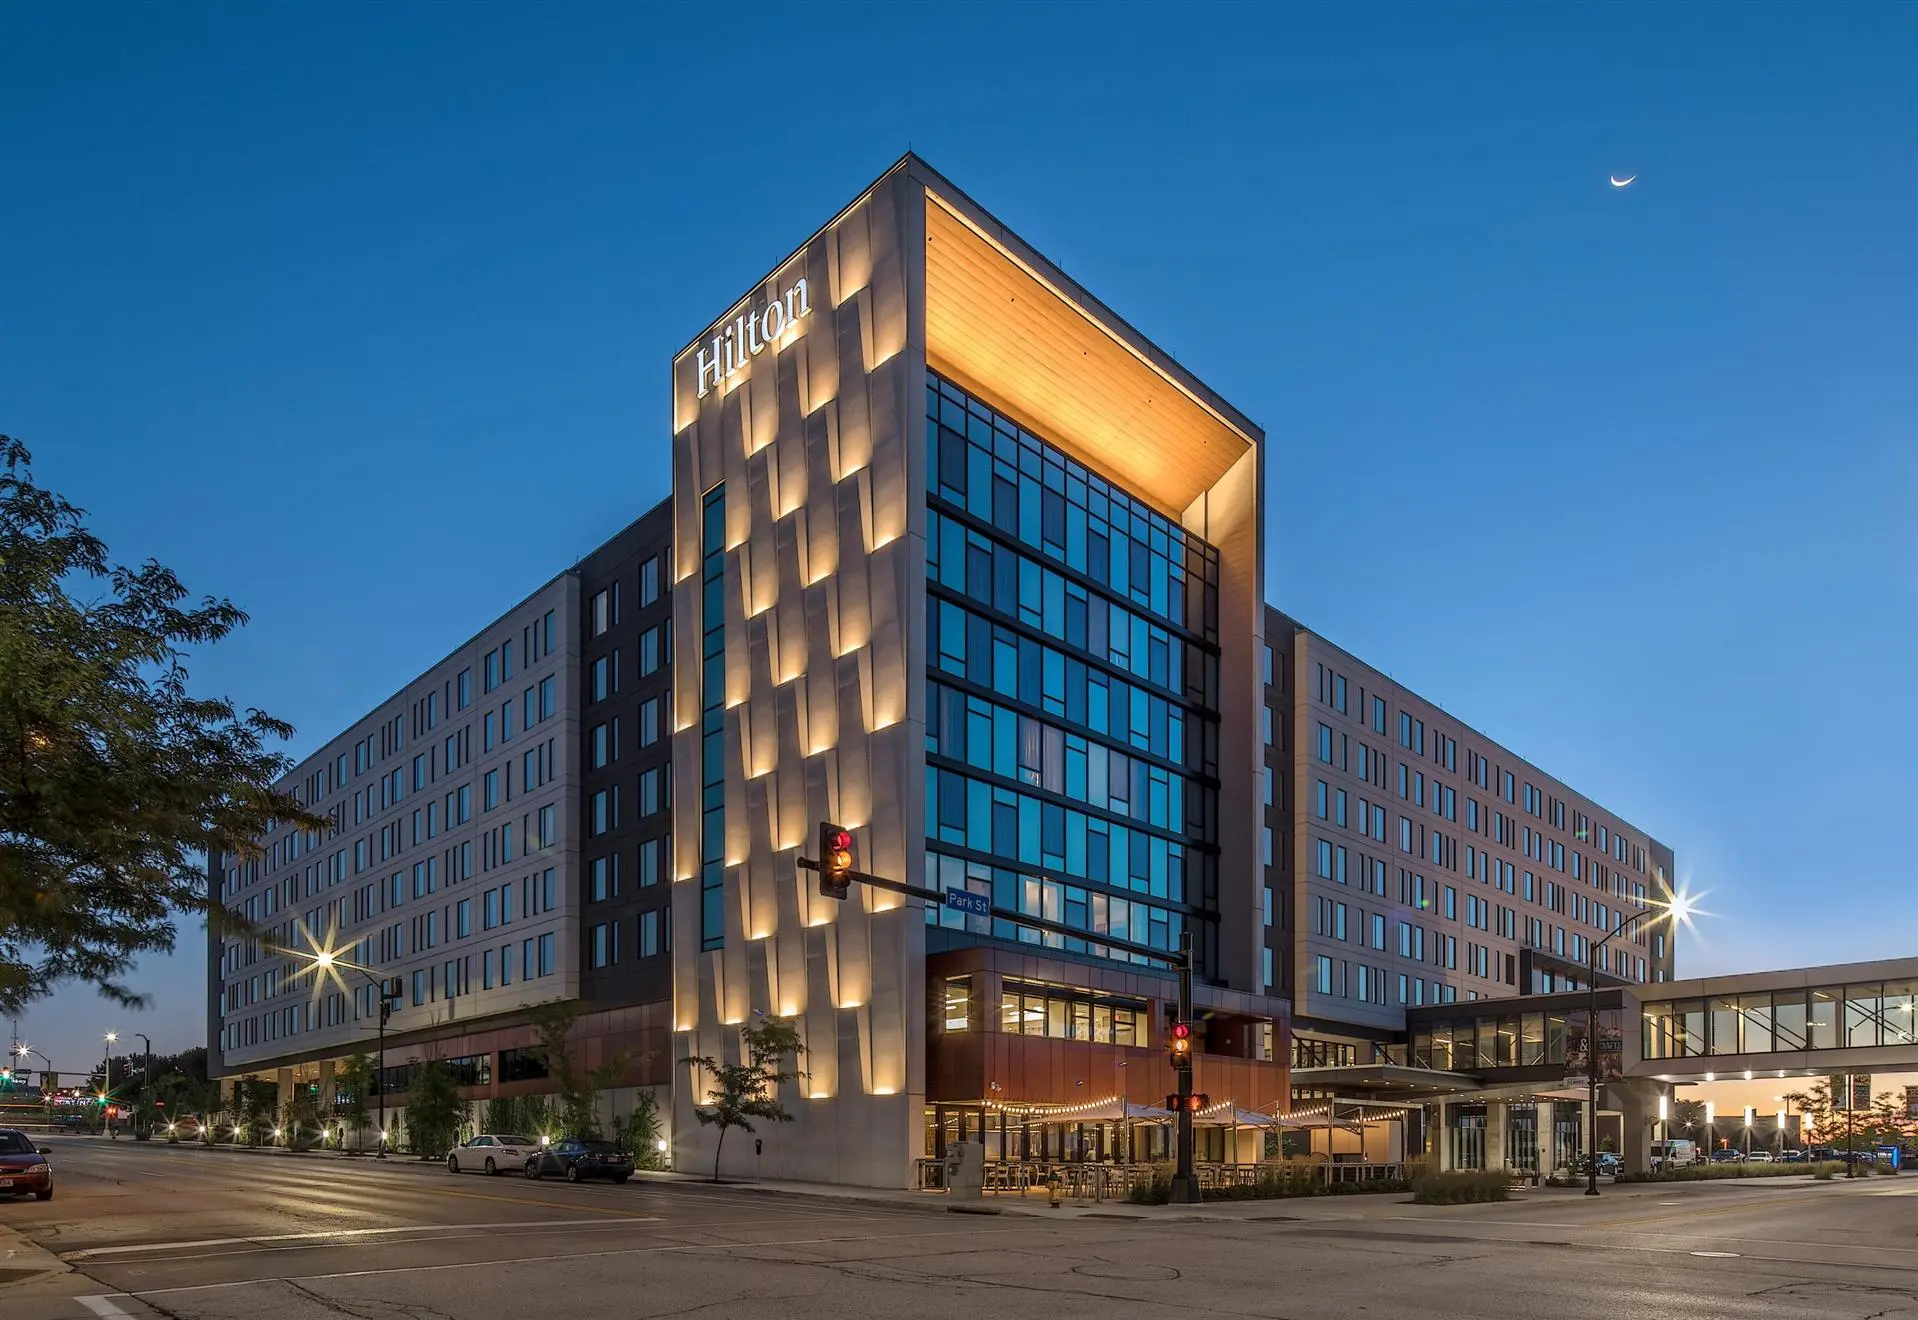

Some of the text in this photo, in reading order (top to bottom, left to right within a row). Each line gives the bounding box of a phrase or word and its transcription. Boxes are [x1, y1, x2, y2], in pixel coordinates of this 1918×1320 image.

[697, 278, 812, 399] Hilton
[950, 892, 987, 912] Park St
[1580, 1038, 1588, 1051] &
